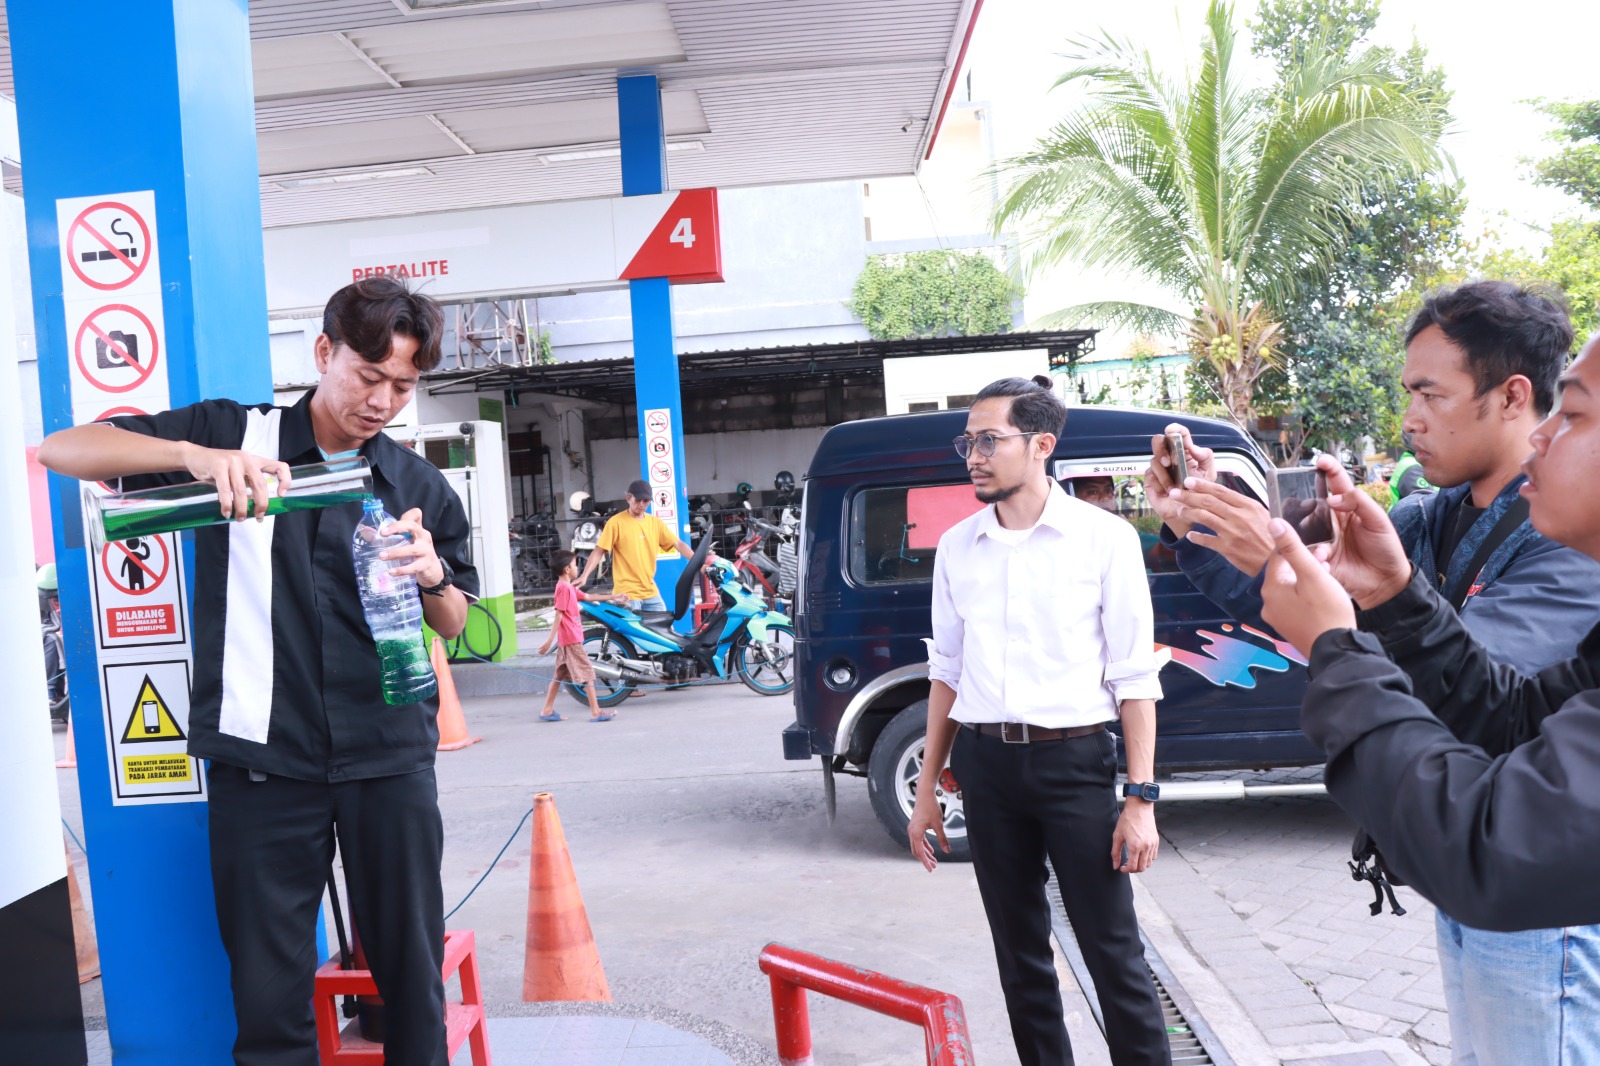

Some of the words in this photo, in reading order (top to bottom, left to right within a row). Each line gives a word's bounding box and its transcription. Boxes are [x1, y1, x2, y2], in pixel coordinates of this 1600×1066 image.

[669, 217, 696, 248] 4
[352, 259, 449, 283] PERTALITE
[115, 609, 165, 620] DILARANG
[136, 624, 167, 632] MENELEPON
